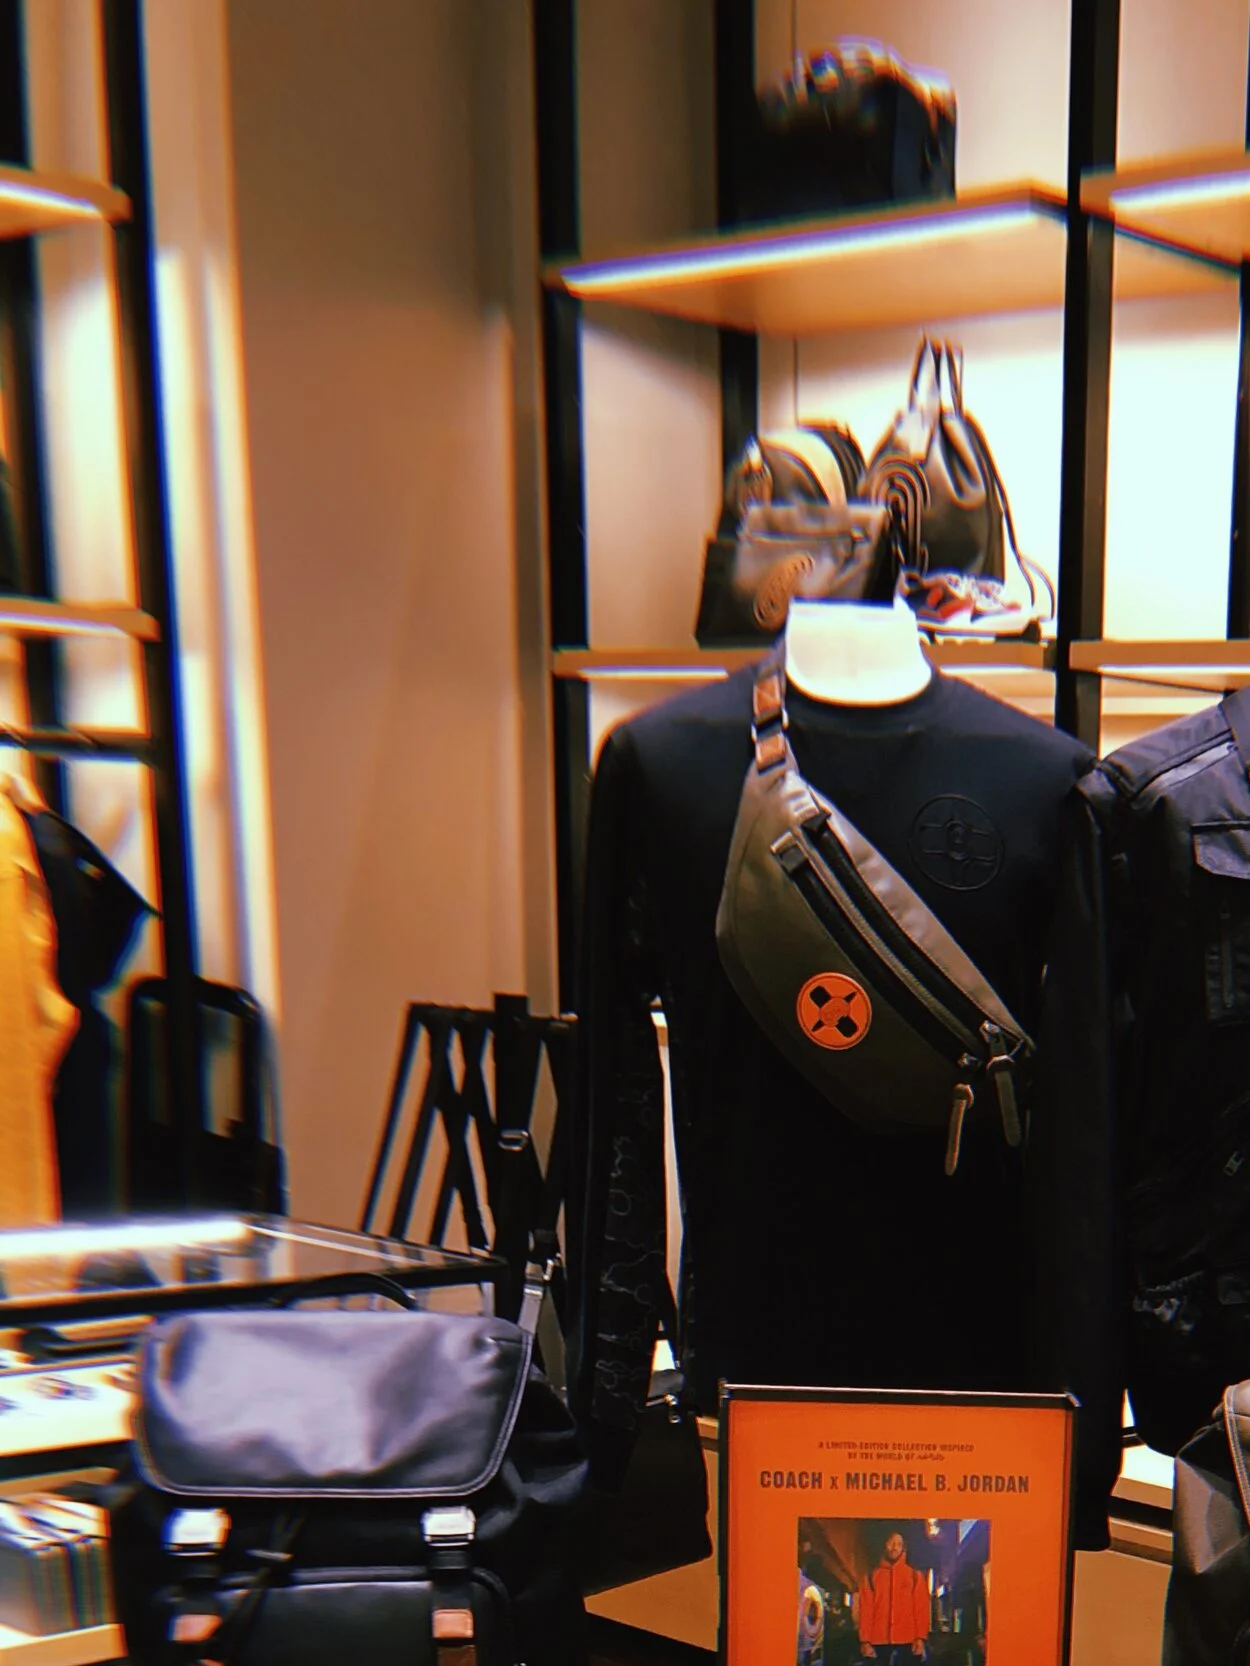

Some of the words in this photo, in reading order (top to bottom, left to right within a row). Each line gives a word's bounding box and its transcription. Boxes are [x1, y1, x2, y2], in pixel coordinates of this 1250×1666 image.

[760, 1470, 823, 1490] COACH
[846, 1472, 927, 1491] MICHAEL
[935, 1474, 951, 1492] B.
[958, 1475, 1029, 1493] JORDAN
